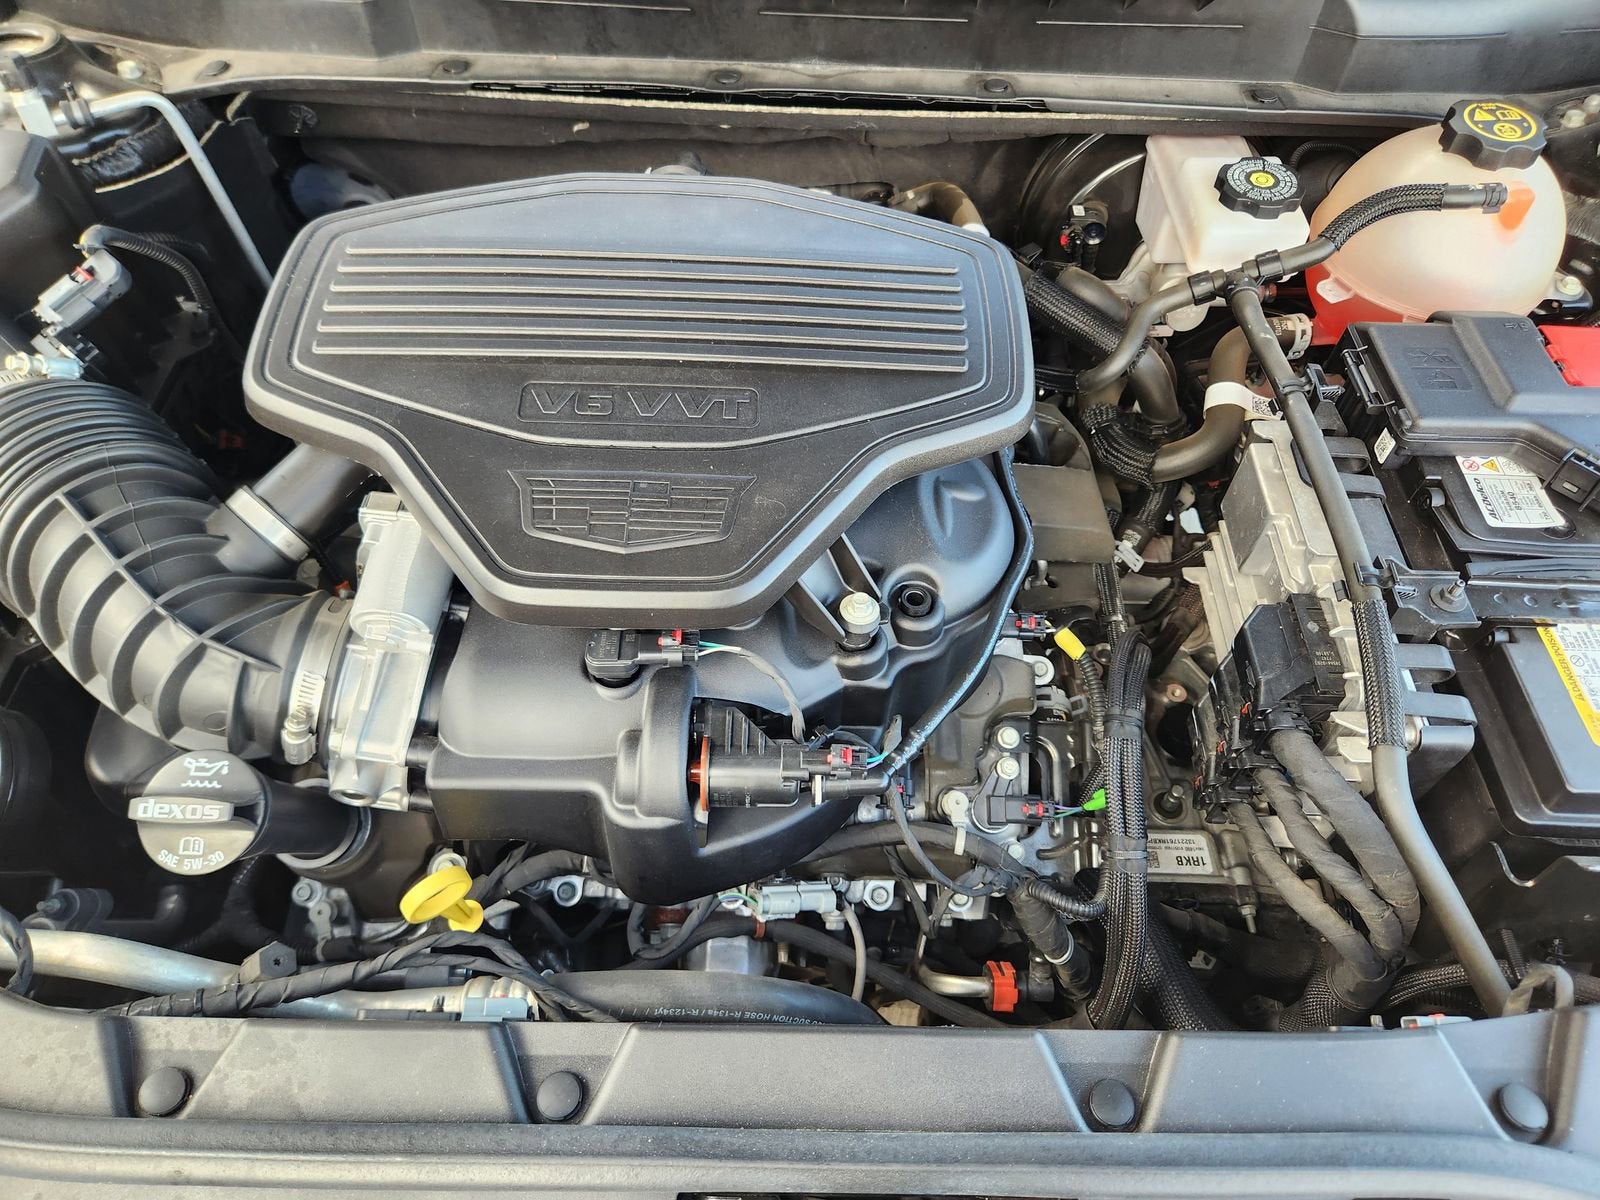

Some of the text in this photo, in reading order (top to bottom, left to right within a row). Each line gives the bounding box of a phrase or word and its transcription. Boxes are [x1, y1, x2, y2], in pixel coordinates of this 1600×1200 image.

[531, 390, 750, 419] V6 VVT
[1473, 477, 1499, 521] ACDelco
[137, 798, 224, 819] dexos
[158, 849, 225, 871] SAE 5W-30
[1175, 856, 1206, 867] 1RKB
[654, 1006, 699, 1016] R-1234yf
[707, 1009, 742, 1018] R-134a
[743, 1011, 771, 1020] HOSE
